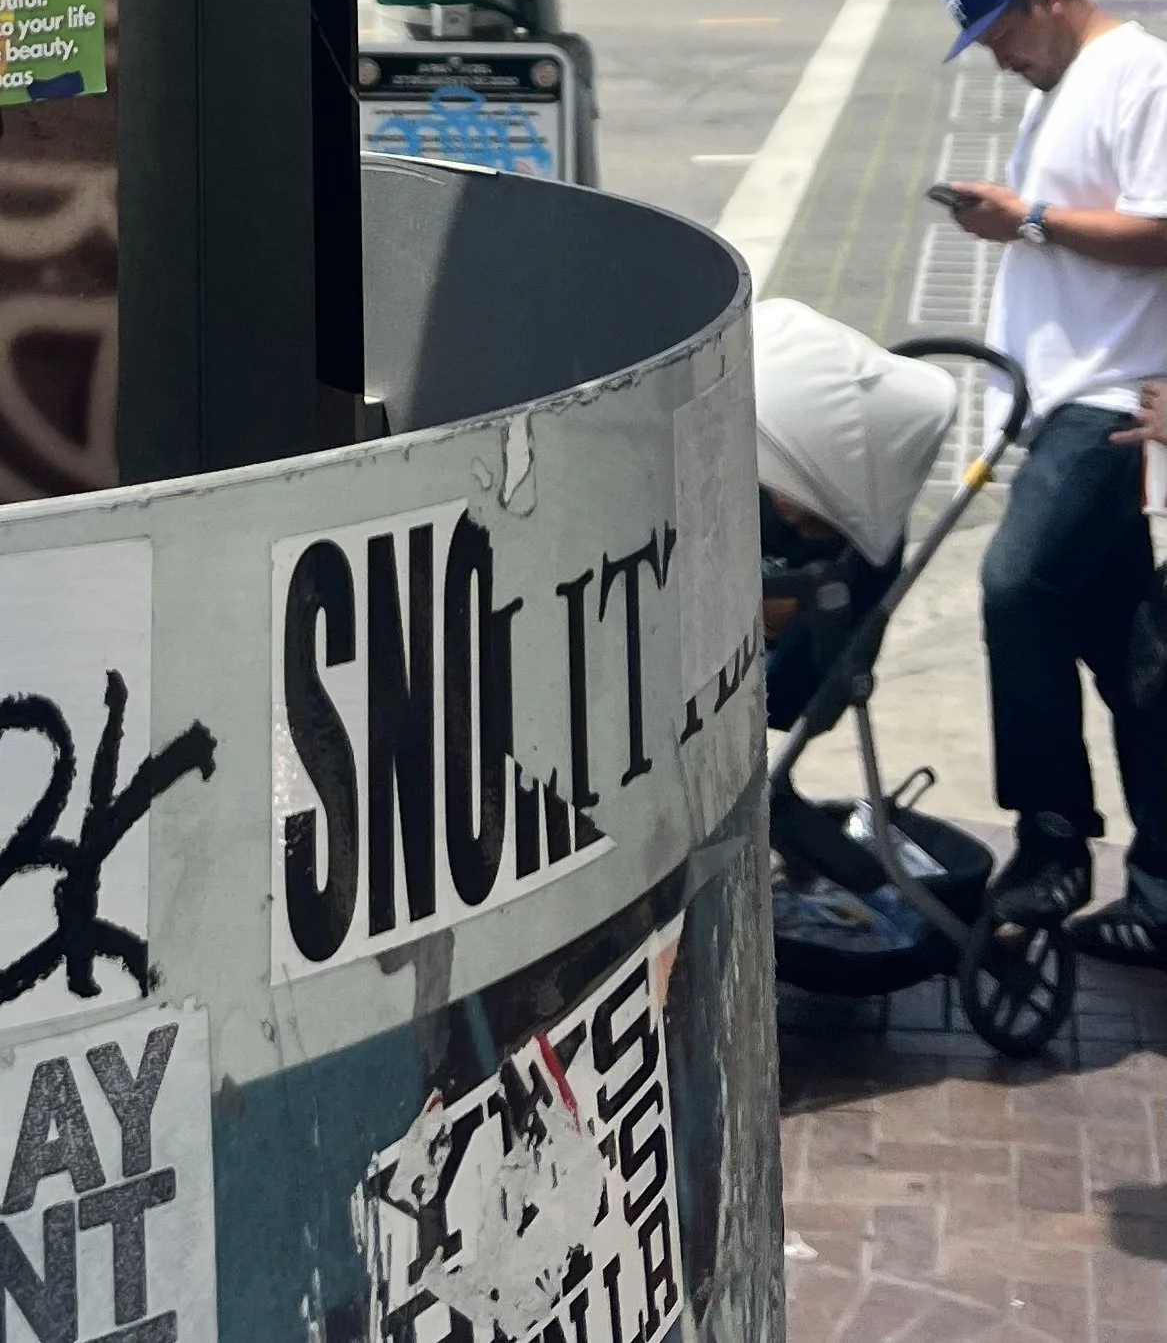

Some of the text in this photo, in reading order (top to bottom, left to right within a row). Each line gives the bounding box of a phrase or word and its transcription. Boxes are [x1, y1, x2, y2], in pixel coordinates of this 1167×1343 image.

[18, 14, 64, 40] your
[67, 4, 97, 29] life
[5, 36, 79, 63] beauty.
